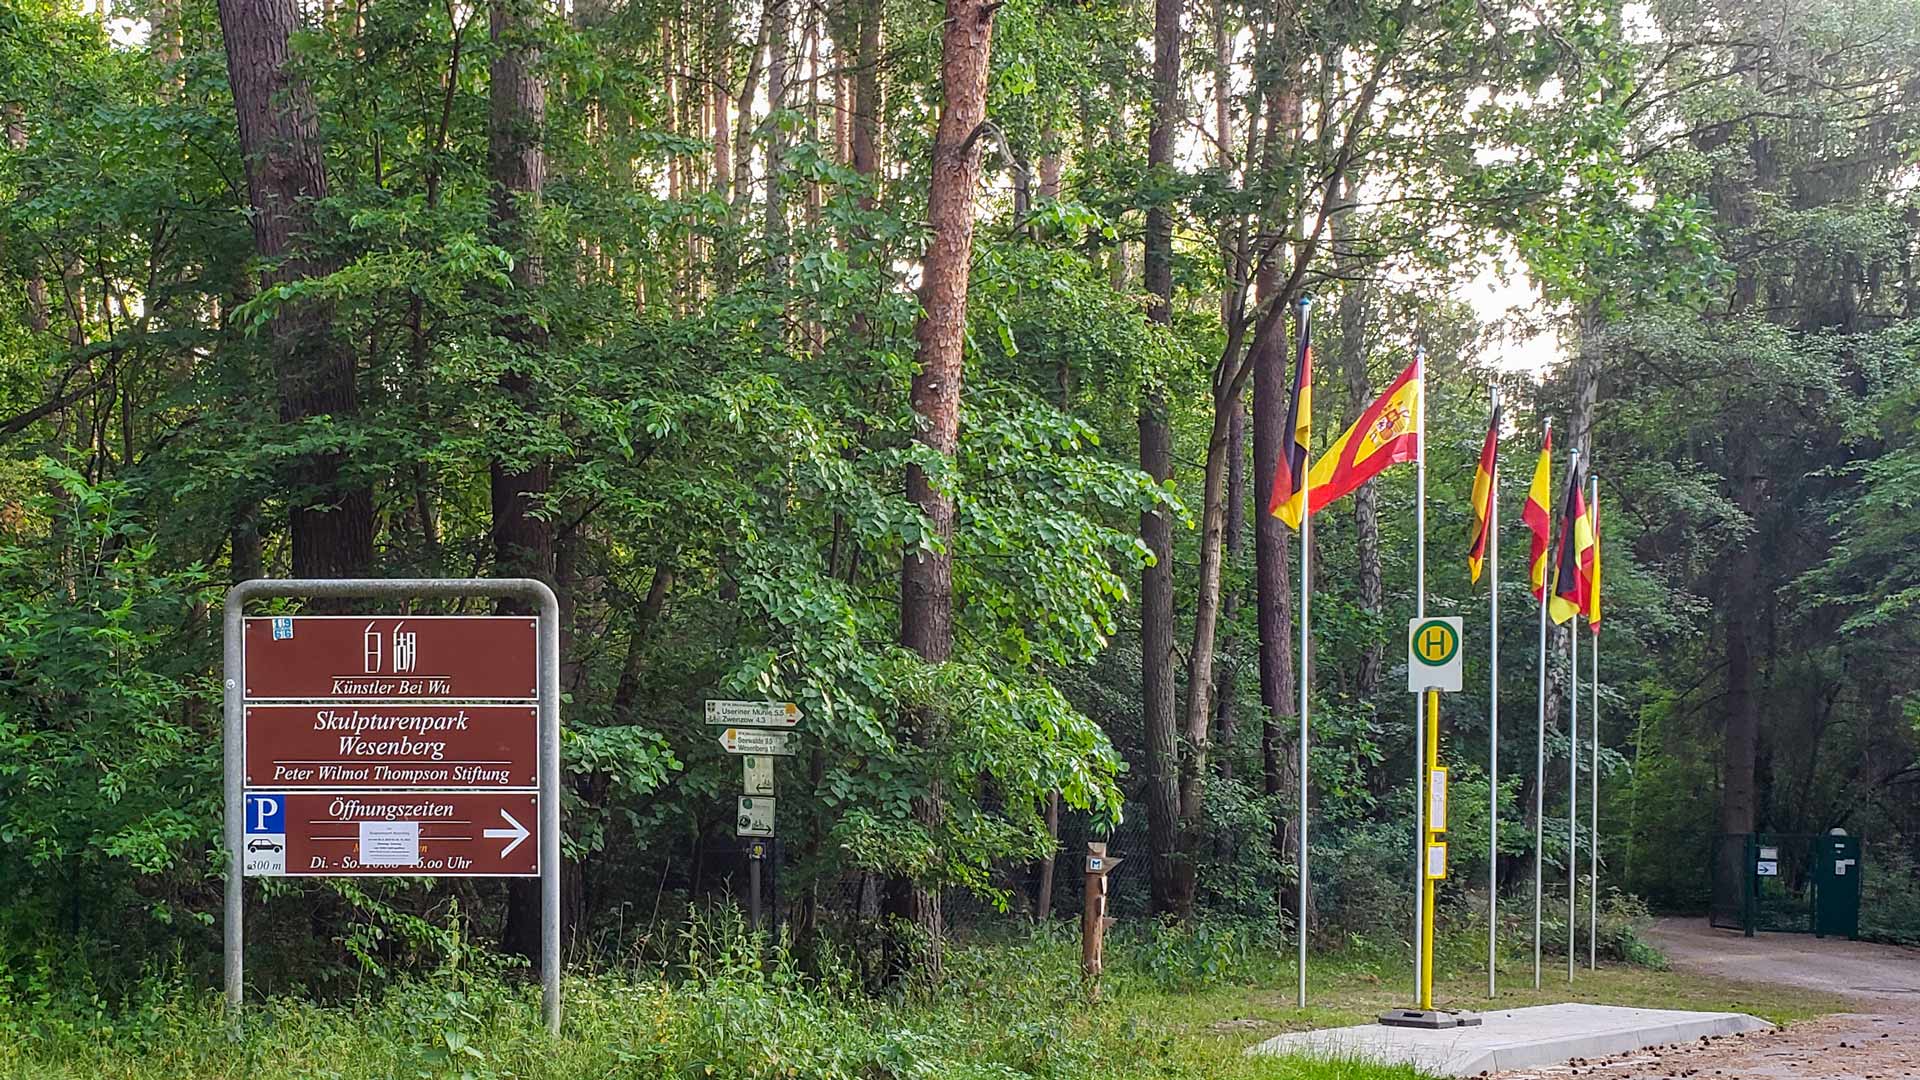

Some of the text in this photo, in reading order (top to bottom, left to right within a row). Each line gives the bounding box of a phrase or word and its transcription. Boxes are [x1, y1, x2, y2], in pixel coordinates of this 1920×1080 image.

[1426, 630, 1445, 656] H
[331, 680, 451, 695] Künstler Bei Wu
[313, 711, 470, 735] Skulpturenpark
[338, 736, 446, 760] Wesenberg
[273, 766, 510, 784] Peter Wilmot Thompson Stiftung
[253, 797, 279, 831] P
[328, 797, 454, 820] Öffnungszeiten
[272, 862, 282, 871] m
[310, 856, 329, 869] Di.
[447, 856, 473, 869] Uhr
